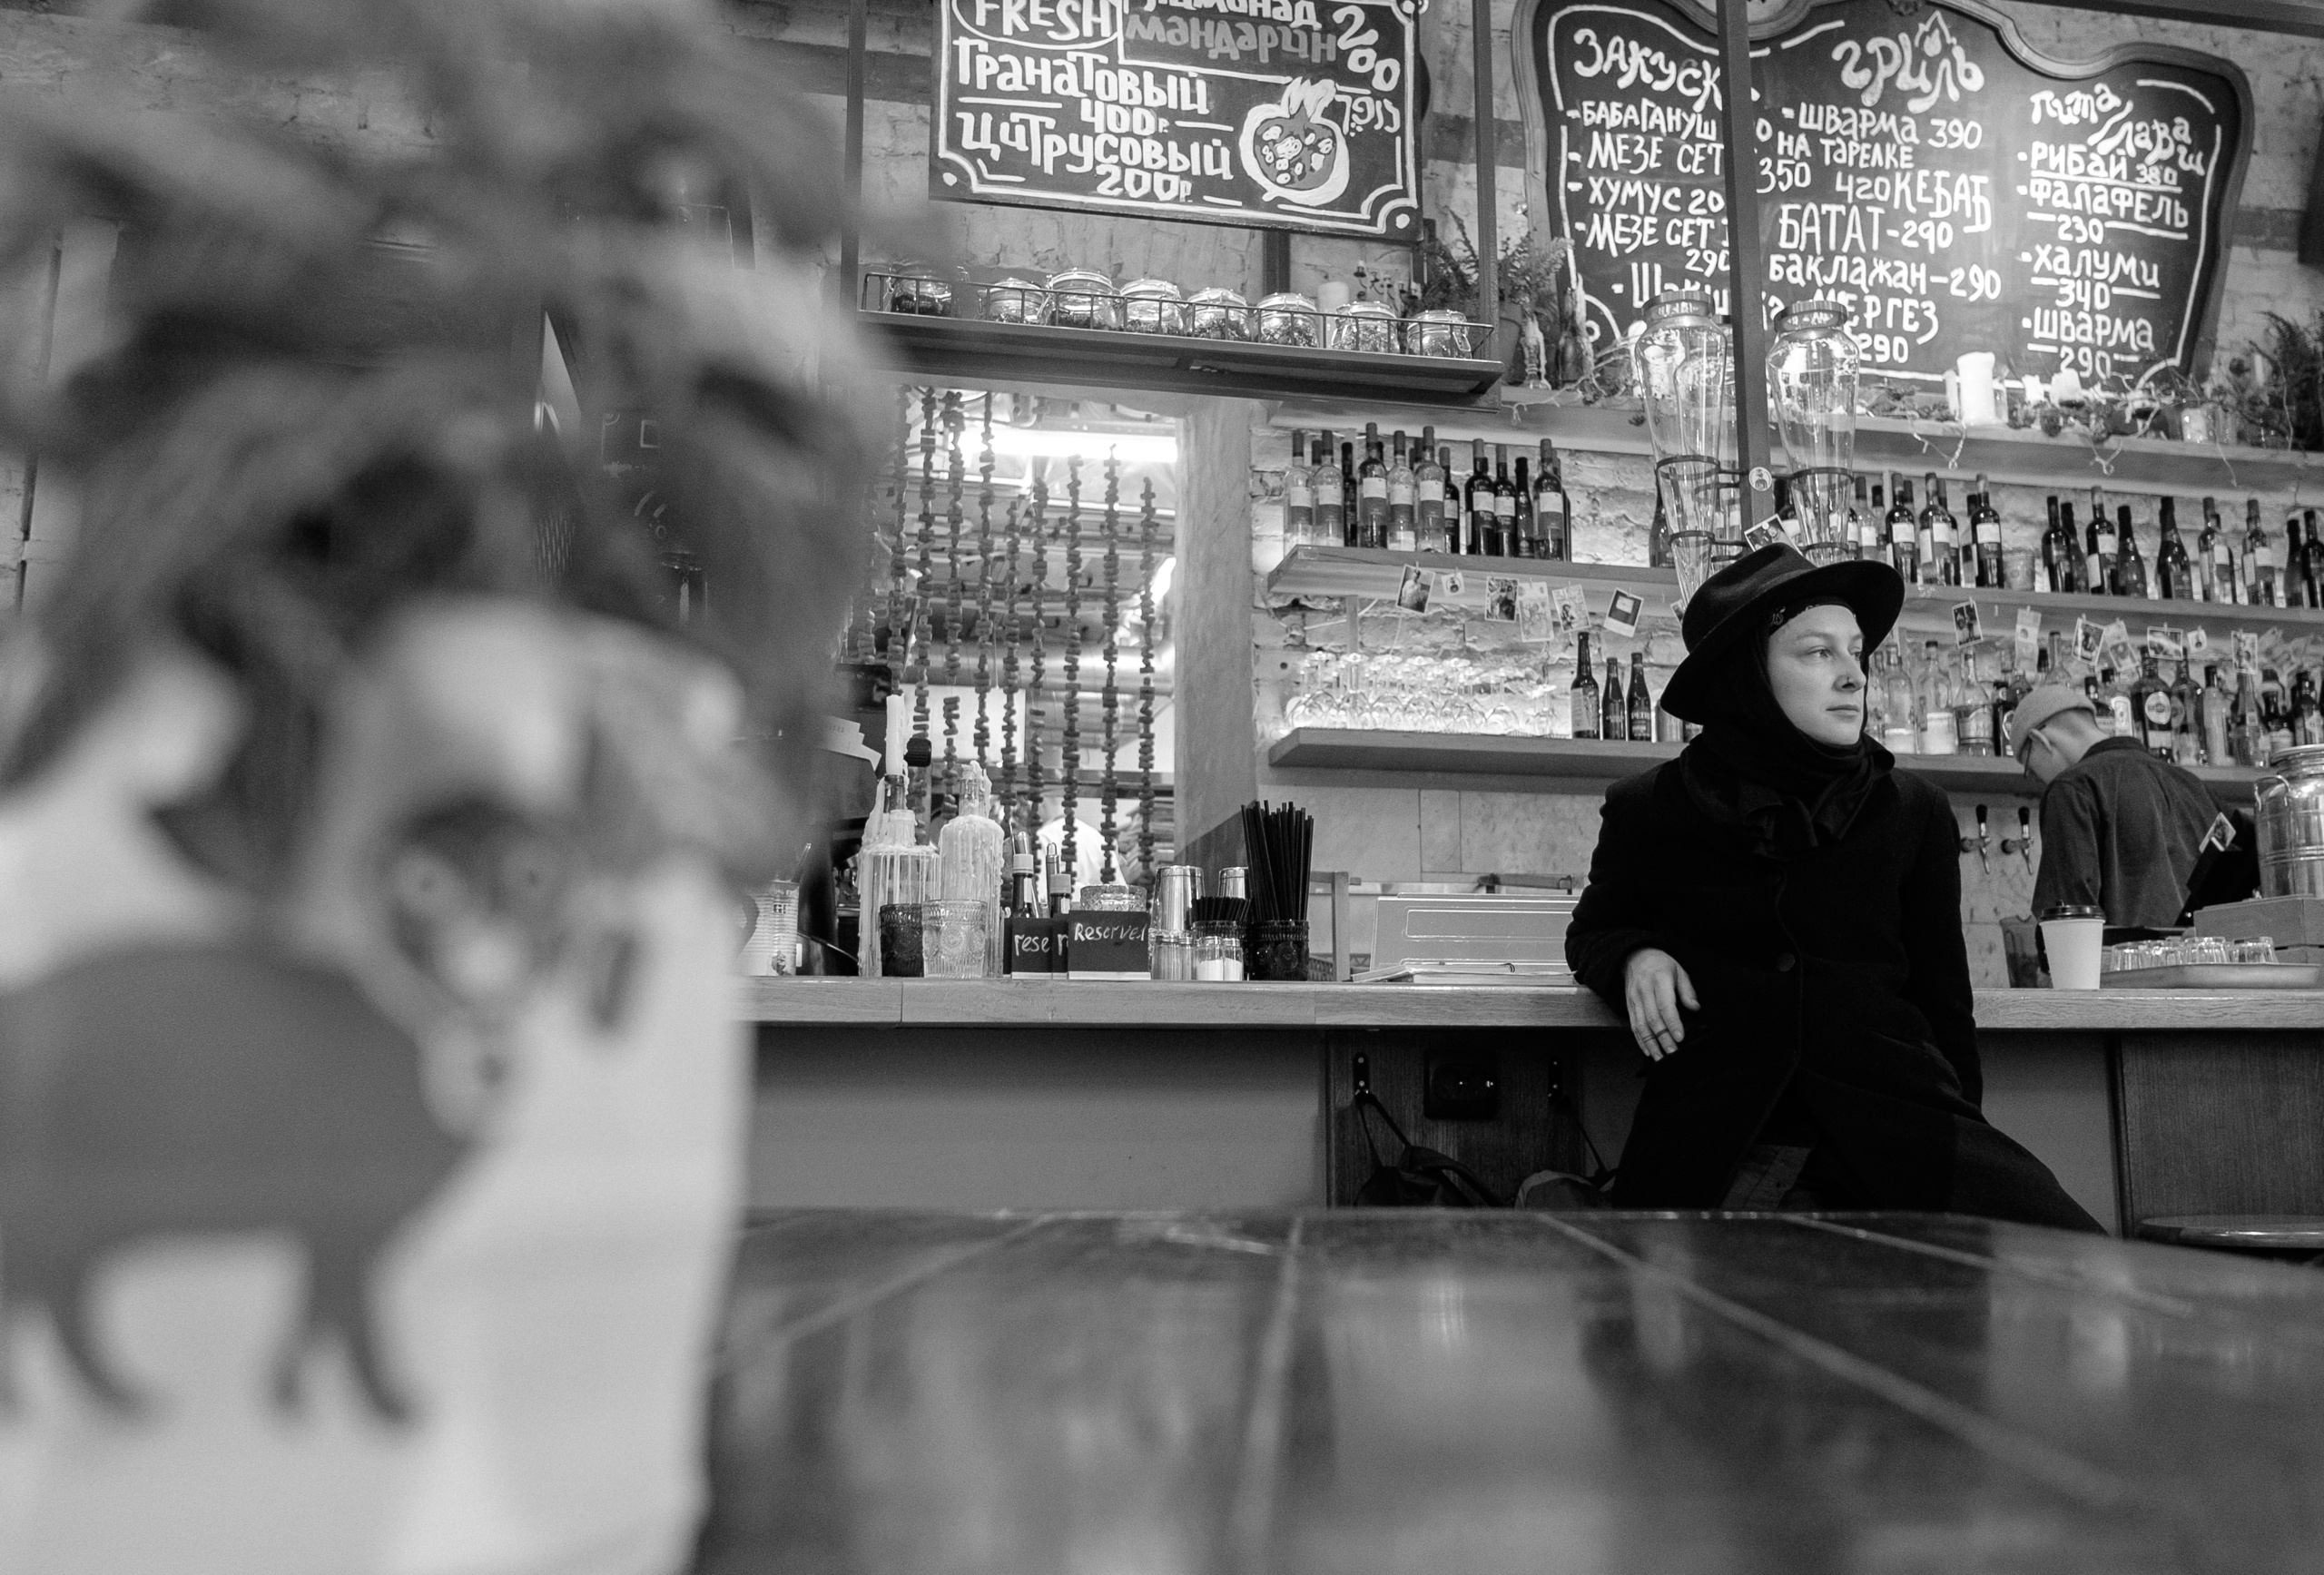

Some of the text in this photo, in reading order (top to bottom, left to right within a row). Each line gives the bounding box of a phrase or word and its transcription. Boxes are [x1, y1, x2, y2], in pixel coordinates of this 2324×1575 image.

[974, 0, 1113, 41] FRESH
[1573, 28, 1761, 113] ЗАКУСК
[1581, 99, 1718, 143] БАБАГАНУШ
[1928, 118, 1983, 150] 390
[1777, 130, 1812, 158] НА
[1587, 131, 1812, 194] МЕЗЕ СЕТ 350
[2134, 163, 2178, 186] 380
[1589, 176, 1681, 215] ХУМУС
[1585, 212, 1659, 258] МЕЗЕ
[1665, 216, 1716, 250] СЕТ
[2057, 216, 2105, 244] 230
[1684, 248, 1730, 278] 290
[2055, 280, 2112, 312] 340
[1857, 333, 1910, 364] 290
[2060, 346, 2112, 379] 290
[1014, 933, 1051, 957] rese
